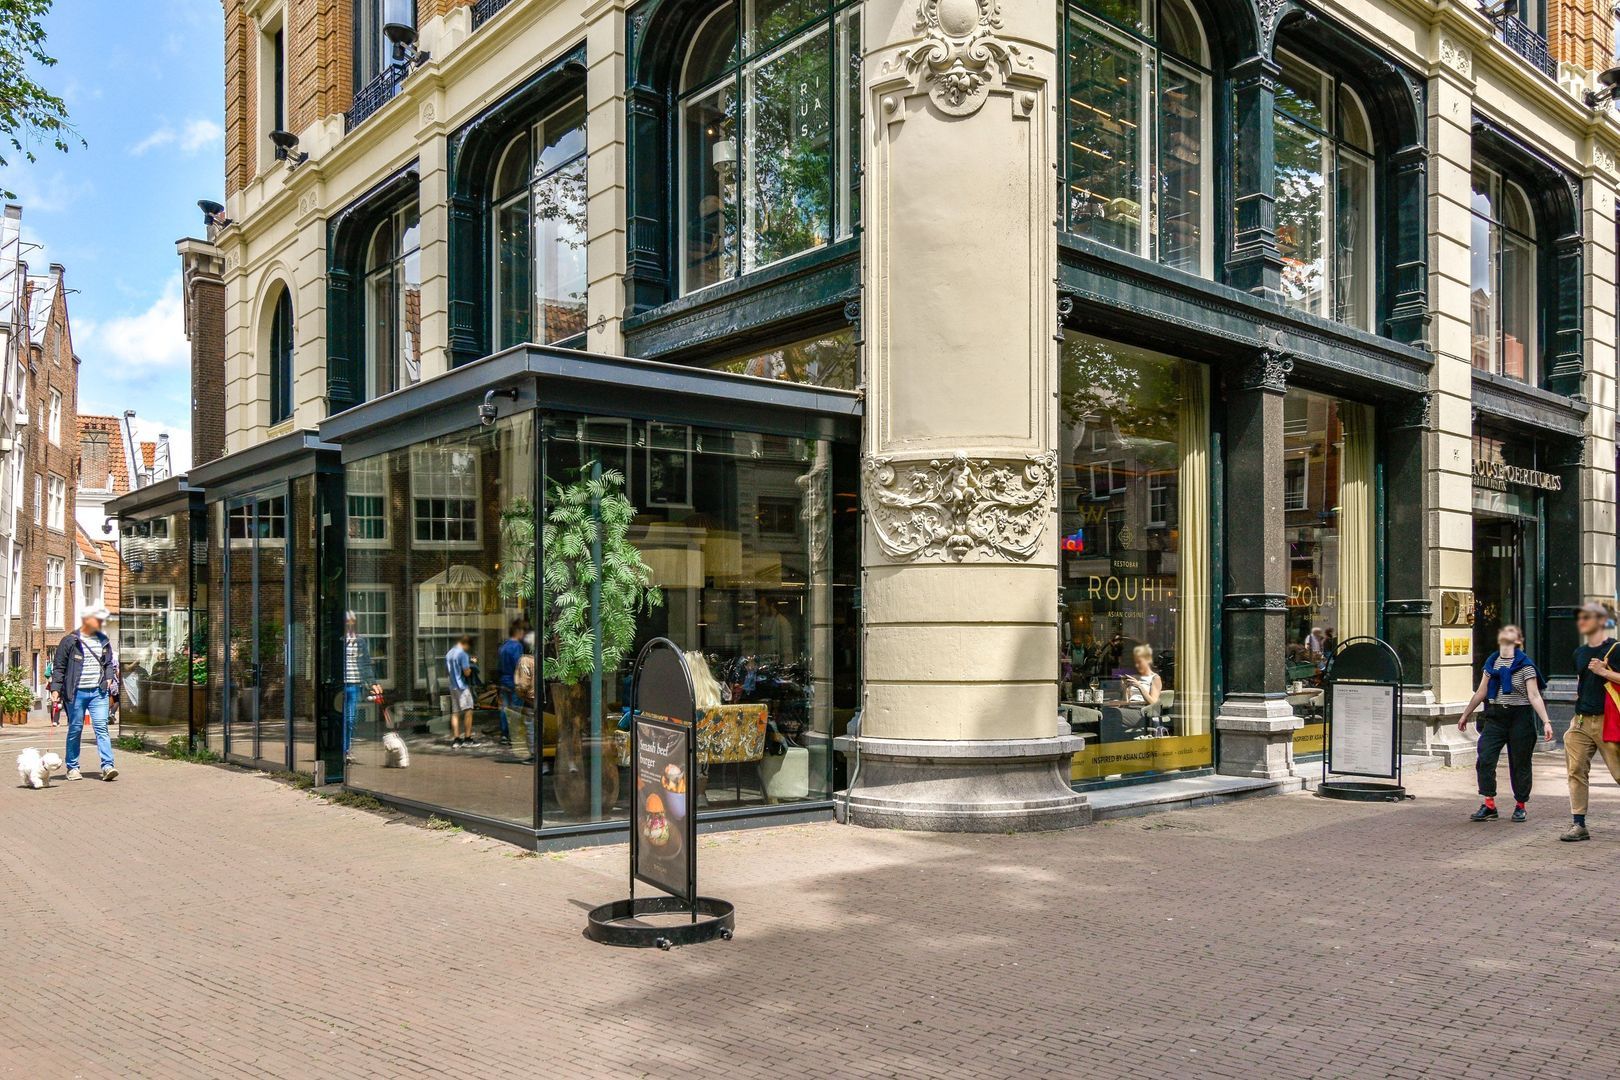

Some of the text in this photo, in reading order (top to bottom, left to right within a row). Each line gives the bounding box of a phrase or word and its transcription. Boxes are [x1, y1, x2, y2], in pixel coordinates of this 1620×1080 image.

[1088, 575, 1162, 602] ROUHI
[656, 742, 670, 756] beef
[639, 753, 656, 768] burger
[1092, 755, 1115, 765] INSPIRED
[1116, 754, 1123, 762] BY
[1122, 752, 1138, 761] ASIAN
[1138, 750, 1159, 760] CUISINE
